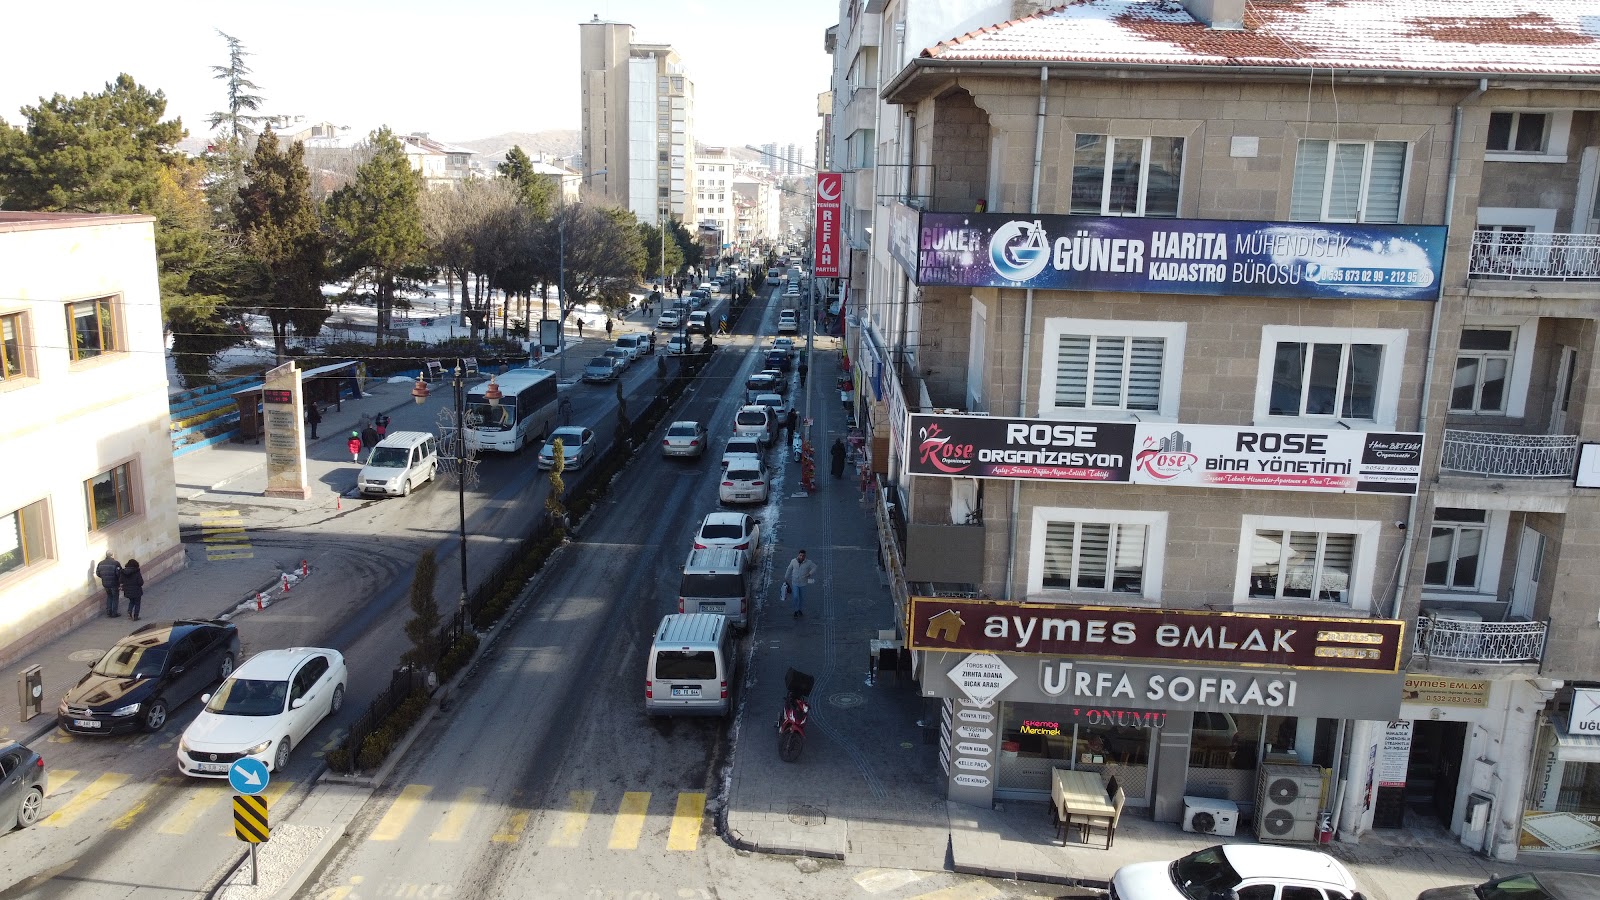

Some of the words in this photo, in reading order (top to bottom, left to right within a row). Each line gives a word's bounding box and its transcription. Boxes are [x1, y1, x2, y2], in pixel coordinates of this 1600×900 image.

[822, 210, 832, 264] REFAH
[920, 223, 980, 251] GÜNER
[1235, 230, 1352, 258] MÜHENDİSLİK
[1053, 230, 1145, 273] GÜNER
[1149, 262, 1226, 283] KADASTRO
[1232, 260, 1300, 284] BÜROSU
[1328, 270, 1344, 281] 535
[1345, 270, 1360, 281] 873
[1362, 271, 1372, 282] 02
[1373, 271, 1384, 282] 99
[1390, 272, 1406, 282] 212
[1407, 272, 1417, 283] 95
[1007, 423, 1098, 447] ROSE
[1236, 432, 1328, 455] ROSE
[919, 438, 974, 472] Rose
[1136, 449, 1187, 479] Rose
[1043, 662, 1135, 699] URFA
[1147, 674, 1297, 707] SOFRASI
[1405, 680, 1446, 688] aymes
[1020, 726, 1060, 736] Mercimek
